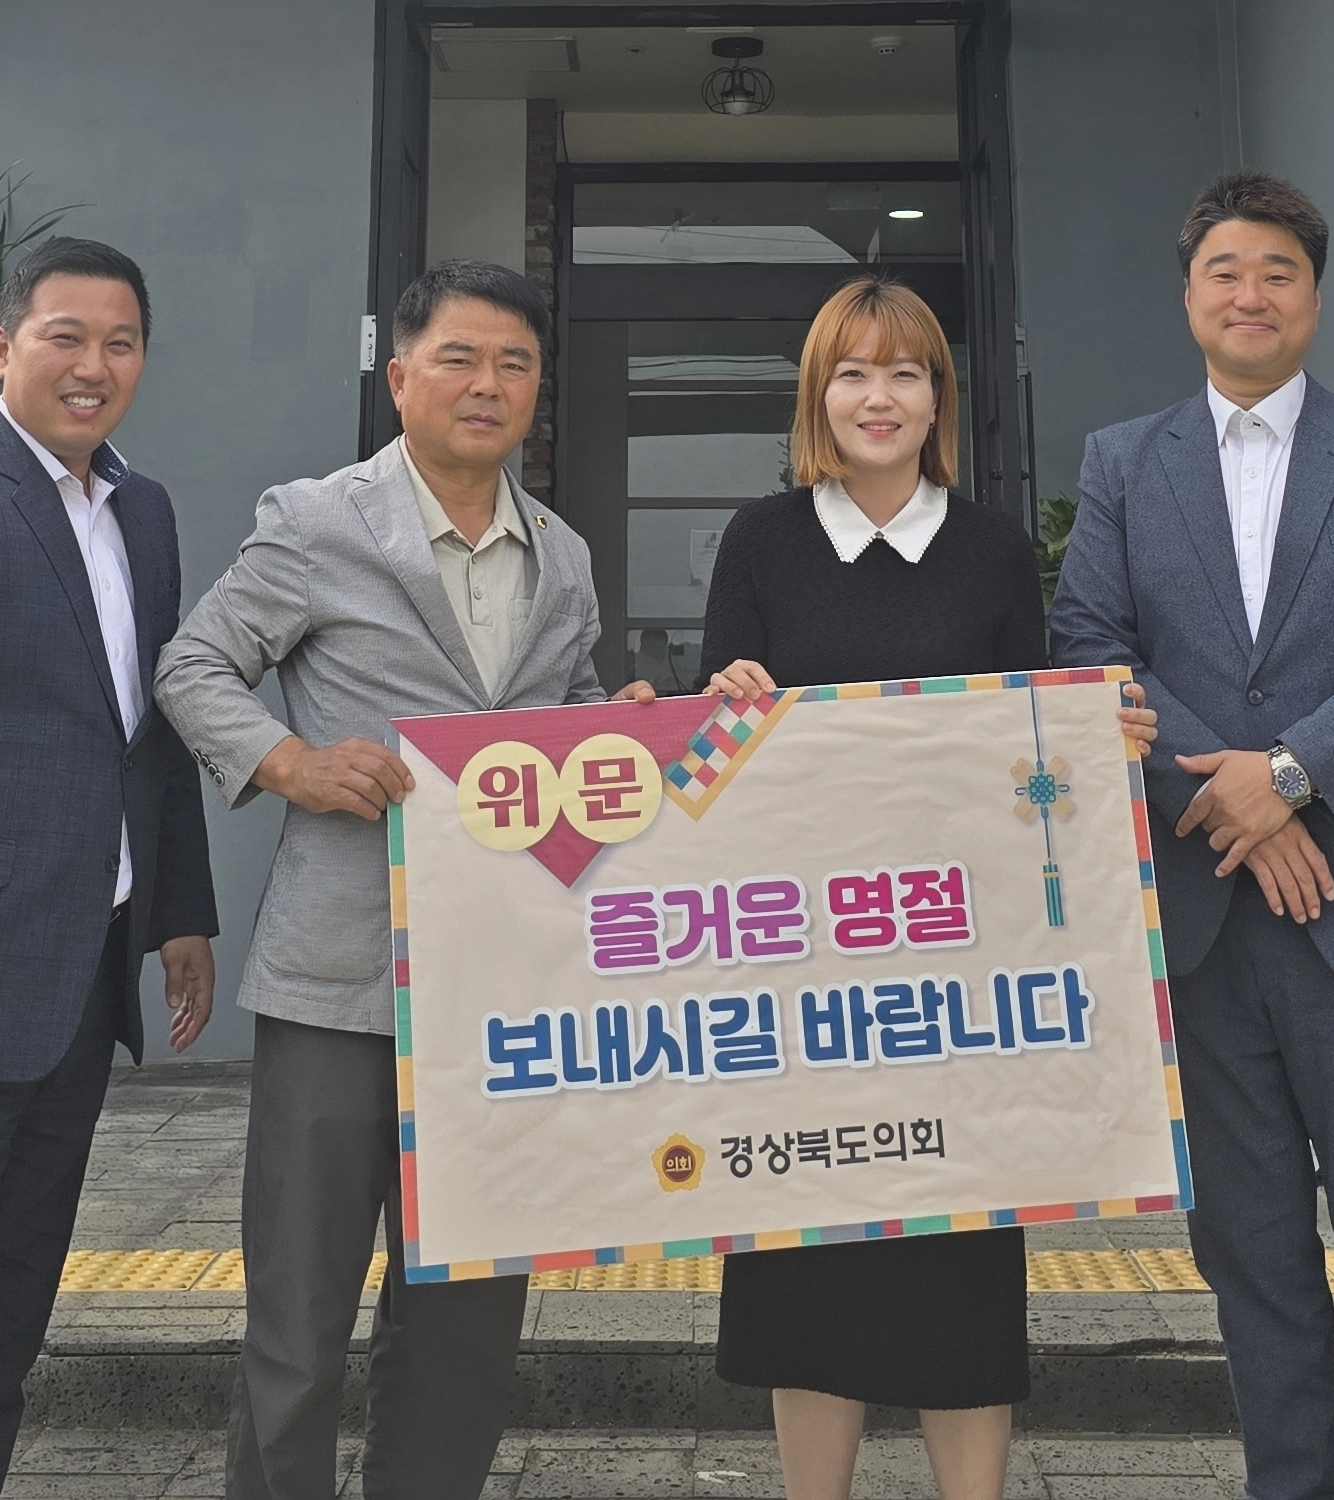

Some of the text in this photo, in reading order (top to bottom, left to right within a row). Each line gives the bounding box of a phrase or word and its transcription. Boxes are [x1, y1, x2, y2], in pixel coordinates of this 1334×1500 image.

[589, 867, 971, 970] 즐거운 명절
[486, 968, 1090, 1092] 보내시길 바랍니다
[665, 1155, 692, 1173] 의회
[720, 1118, 946, 1179] 경상북도의회
